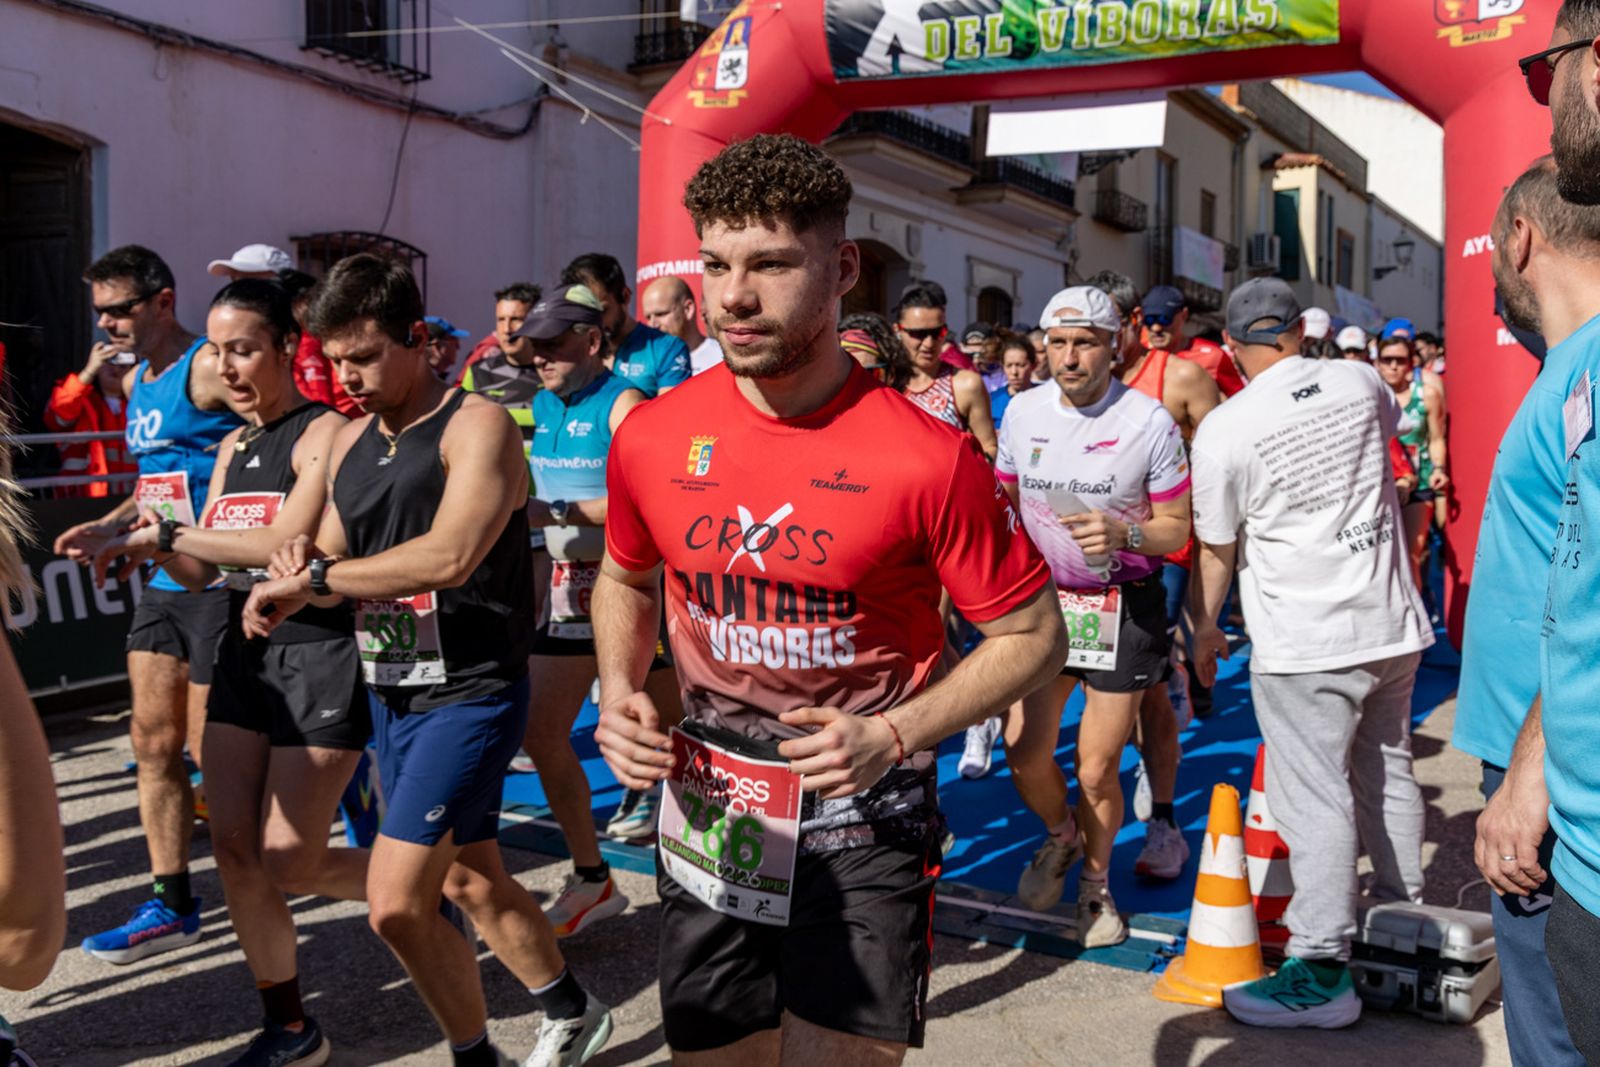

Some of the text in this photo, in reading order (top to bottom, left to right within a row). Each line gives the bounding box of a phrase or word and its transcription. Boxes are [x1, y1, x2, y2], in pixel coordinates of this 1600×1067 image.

[922, 0, 1277, 63] DEL VÍBORAS
[1291, 382, 1322, 403] PONY
[213, 500, 266, 519] X CROSS
[809, 479, 870, 494] TEAMERGY
[685, 515, 834, 566] CROSS
[1349, 536, 1375, 555] NEW
[709, 613, 858, 670] VÍBORAS
[684, 743, 699, 778] X
[701, 762, 770, 804] CROSS
[681, 790, 764, 873] 786
